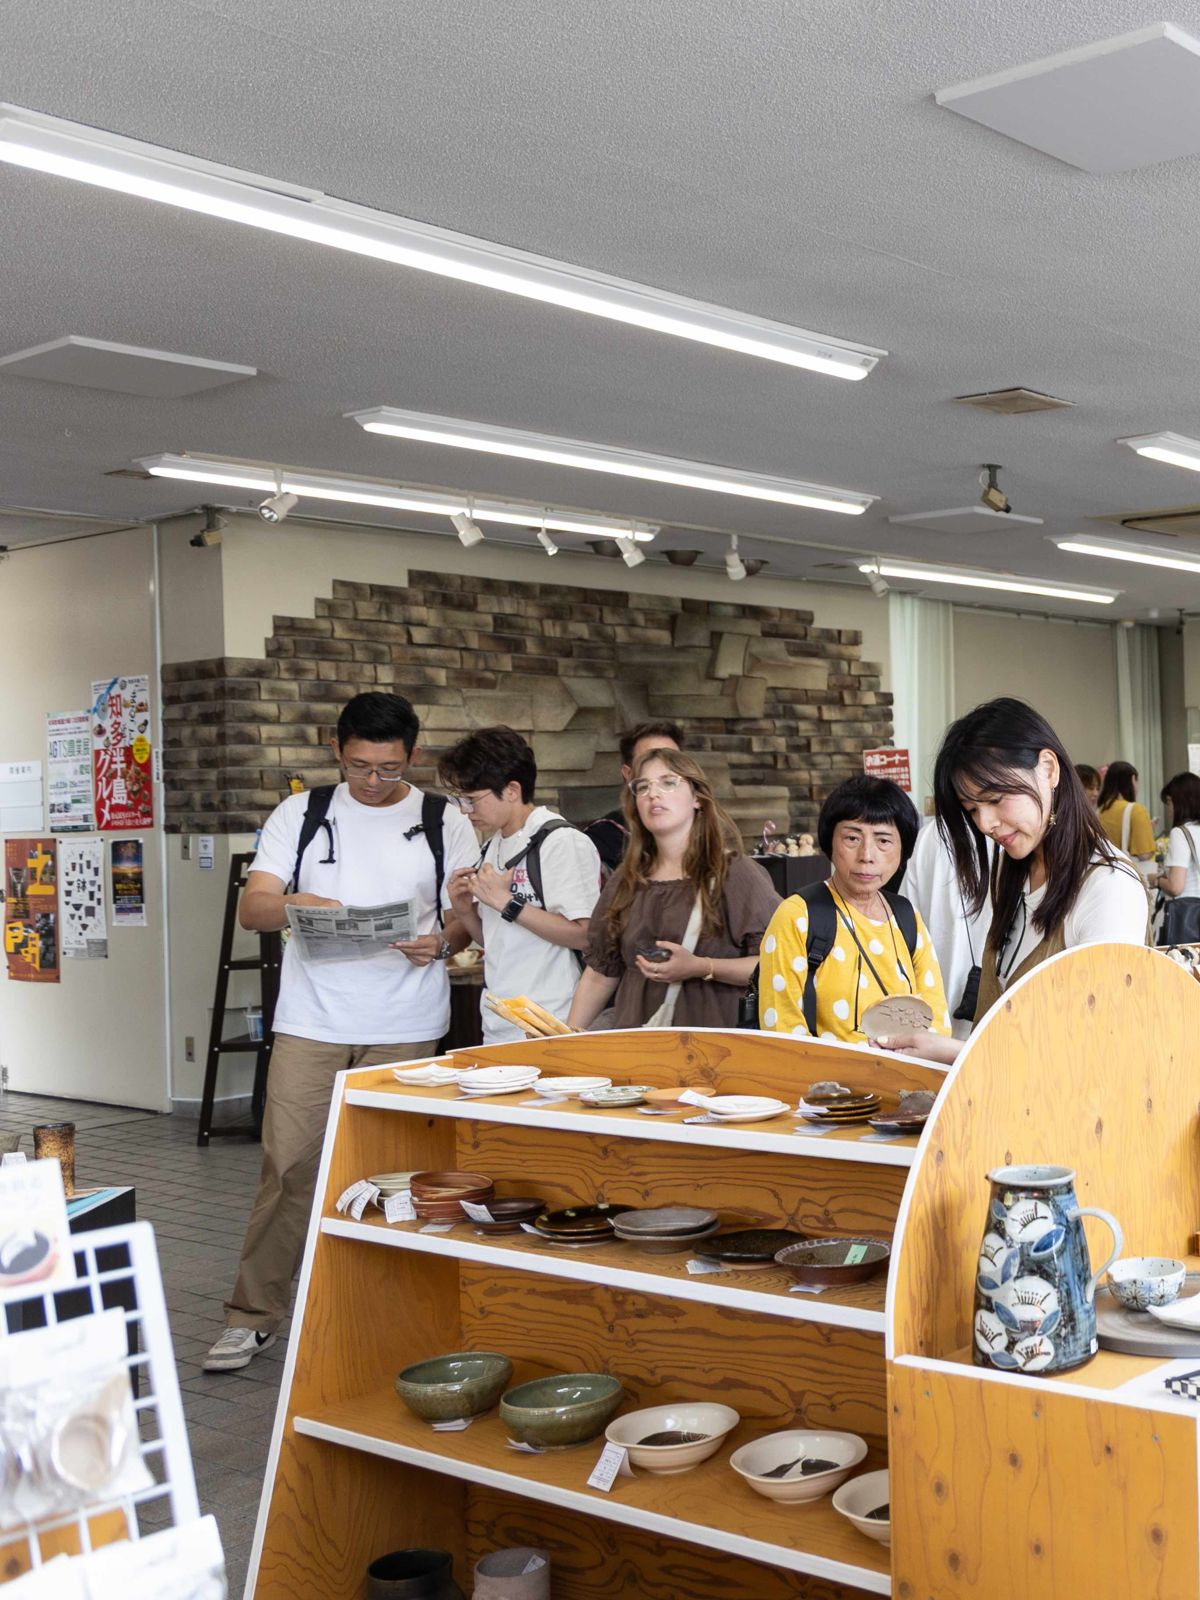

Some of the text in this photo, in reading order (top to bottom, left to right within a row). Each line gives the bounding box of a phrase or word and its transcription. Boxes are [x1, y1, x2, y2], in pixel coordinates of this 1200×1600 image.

[95, 748, 113, 829] グルメ
[107, 692, 129, 805] 知多半島
